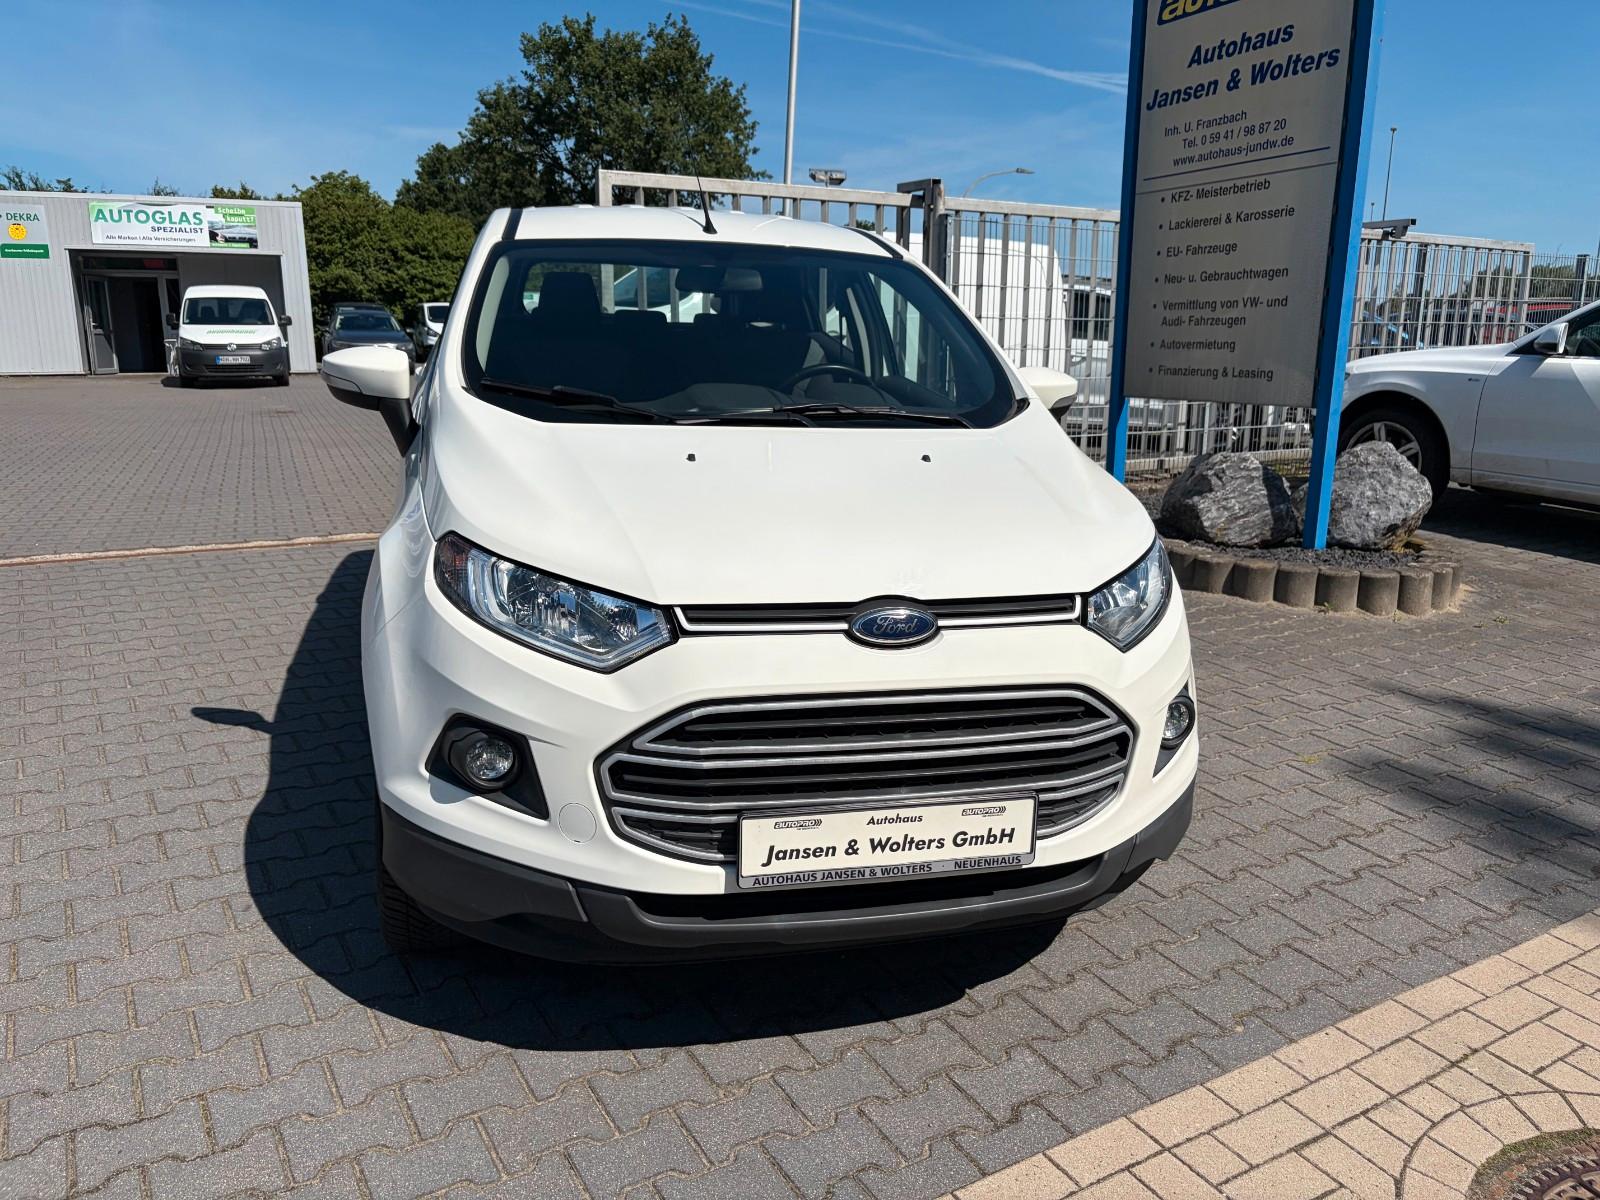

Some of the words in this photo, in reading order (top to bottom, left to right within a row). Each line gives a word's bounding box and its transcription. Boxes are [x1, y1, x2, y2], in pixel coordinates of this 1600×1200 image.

[1187, 24, 1295, 68] Autohaus
[1146, 79, 1219, 111] Jansen
[1226, 68, 1241, 92] &
[1250, 48, 1341, 86] Wolters
[1164, 125, 1181, 137] Inh.
[1184, 122, 1194, 133] U.
[1196, 110, 1247, 131] Franzbach
[1182, 137, 1198, 149] Tel.
[1201, 135, 1207, 146] 0
[1209, 132, 1221, 144] 59
[1223, 129, 1234, 141] 41
[1243, 125, 1255, 137] 98
[1258, 121, 1271, 134] 87
[1273, 118, 1287, 131] 20
[1172, 135, 1295, 167] www.autohaus-jundw.de
[1196, 178, 1271, 200] Meisterbetrieb
[5, 212, 40, 222] DEKRA
[93, 208, 203, 226] AUTOGLAS
[1168, 213, 1222, 231] Lackiererei
[1225, 212, 1232, 224] &
[1236, 205, 1295, 223] Karosserie
[151, 225, 204, 234] SPEZIALIST
[153, 235, 196, 243] Versicherungen
[1166, 246, 1183, 258] EU-
[1186, 242, 1238, 256] Fahrzeuge
[1164, 273, 1186, 284] Neu-
[1188, 275, 1197, 283] u.
[1200, 267, 1289, 282] Gebrauchtwagen
[1162, 299, 1217, 312] Vermittlung
[1220, 299, 1238, 310] von
[1242, 296, 1263, 308] VW-
[1266, 296, 1288, 308] und
[1160, 315, 1185, 327] Audi-
[1188, 315, 1246, 328] Fahrzeugen
[1160, 339, 1236, 352] Autovermietung
[1158, 365, 1219, 380] Finanzierung
[1222, 367, 1229, 378] &
[1232, 367, 1274, 382] Leasing
[873, 615, 918, 634] Ford
[867, 813, 923, 825] Autohaus
[760, 845, 837, 867] Jansen
[844, 839, 860, 856] &
[869, 833, 946, 854] Wolters
[952, 827, 1015, 848] GmbH
[752, 872, 818, 886] AUTOHAUS
[820, 869, 866, 881] JANSEN
[869, 868, 877, 877] &
[880, 863, 933, 876] WOLTERS
[954, 856, 1021, 869] NEUENHAUS
